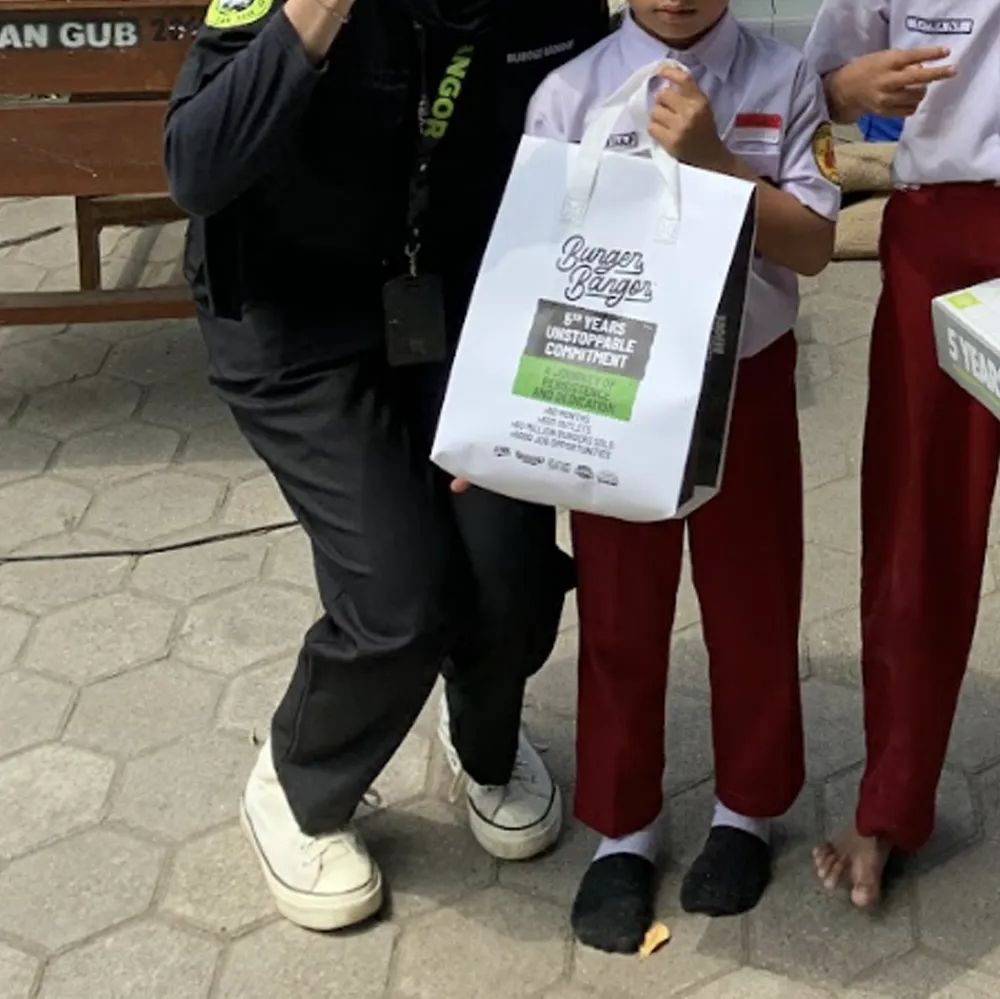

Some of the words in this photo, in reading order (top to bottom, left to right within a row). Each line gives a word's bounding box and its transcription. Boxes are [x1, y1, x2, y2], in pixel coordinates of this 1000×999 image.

[58, 22, 139, 48] GUB
[423, 45, 475, 140] NGOR
[556, 234, 645, 276] Burger
[564, 264, 654, 308] Bangor
[584, 315, 627, 335] YEARS
[545, 326, 638, 353] UNSTOPPABLE
[543, 342, 629, 369] COMMITMENT
